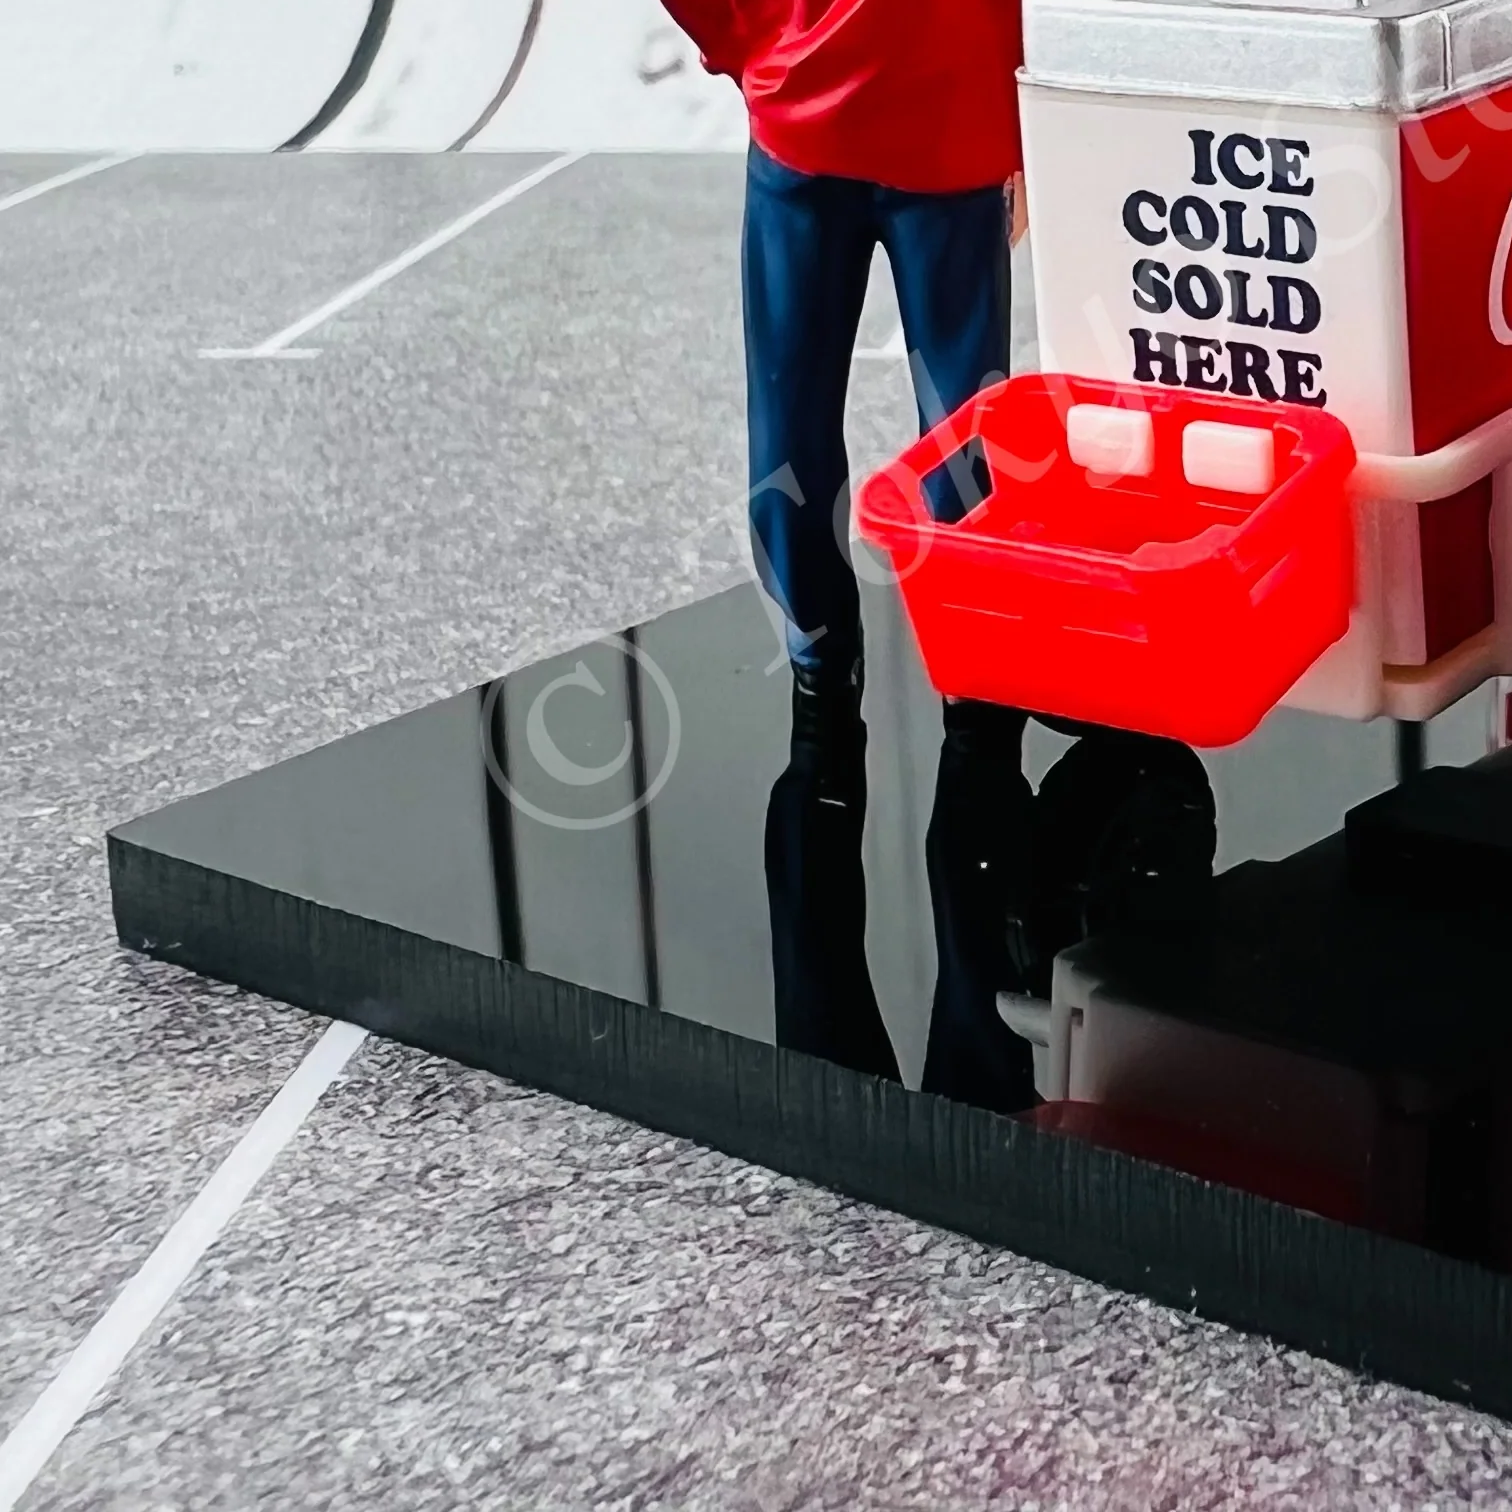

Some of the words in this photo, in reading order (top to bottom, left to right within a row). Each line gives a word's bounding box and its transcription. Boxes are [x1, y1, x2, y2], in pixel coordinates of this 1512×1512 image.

[1188, 129, 1313, 197] ICE
[1122, 189, 1317, 264] COLD
[1131, 258, 1322, 335] SOLD
[1129, 328, 1327, 408] HERE
